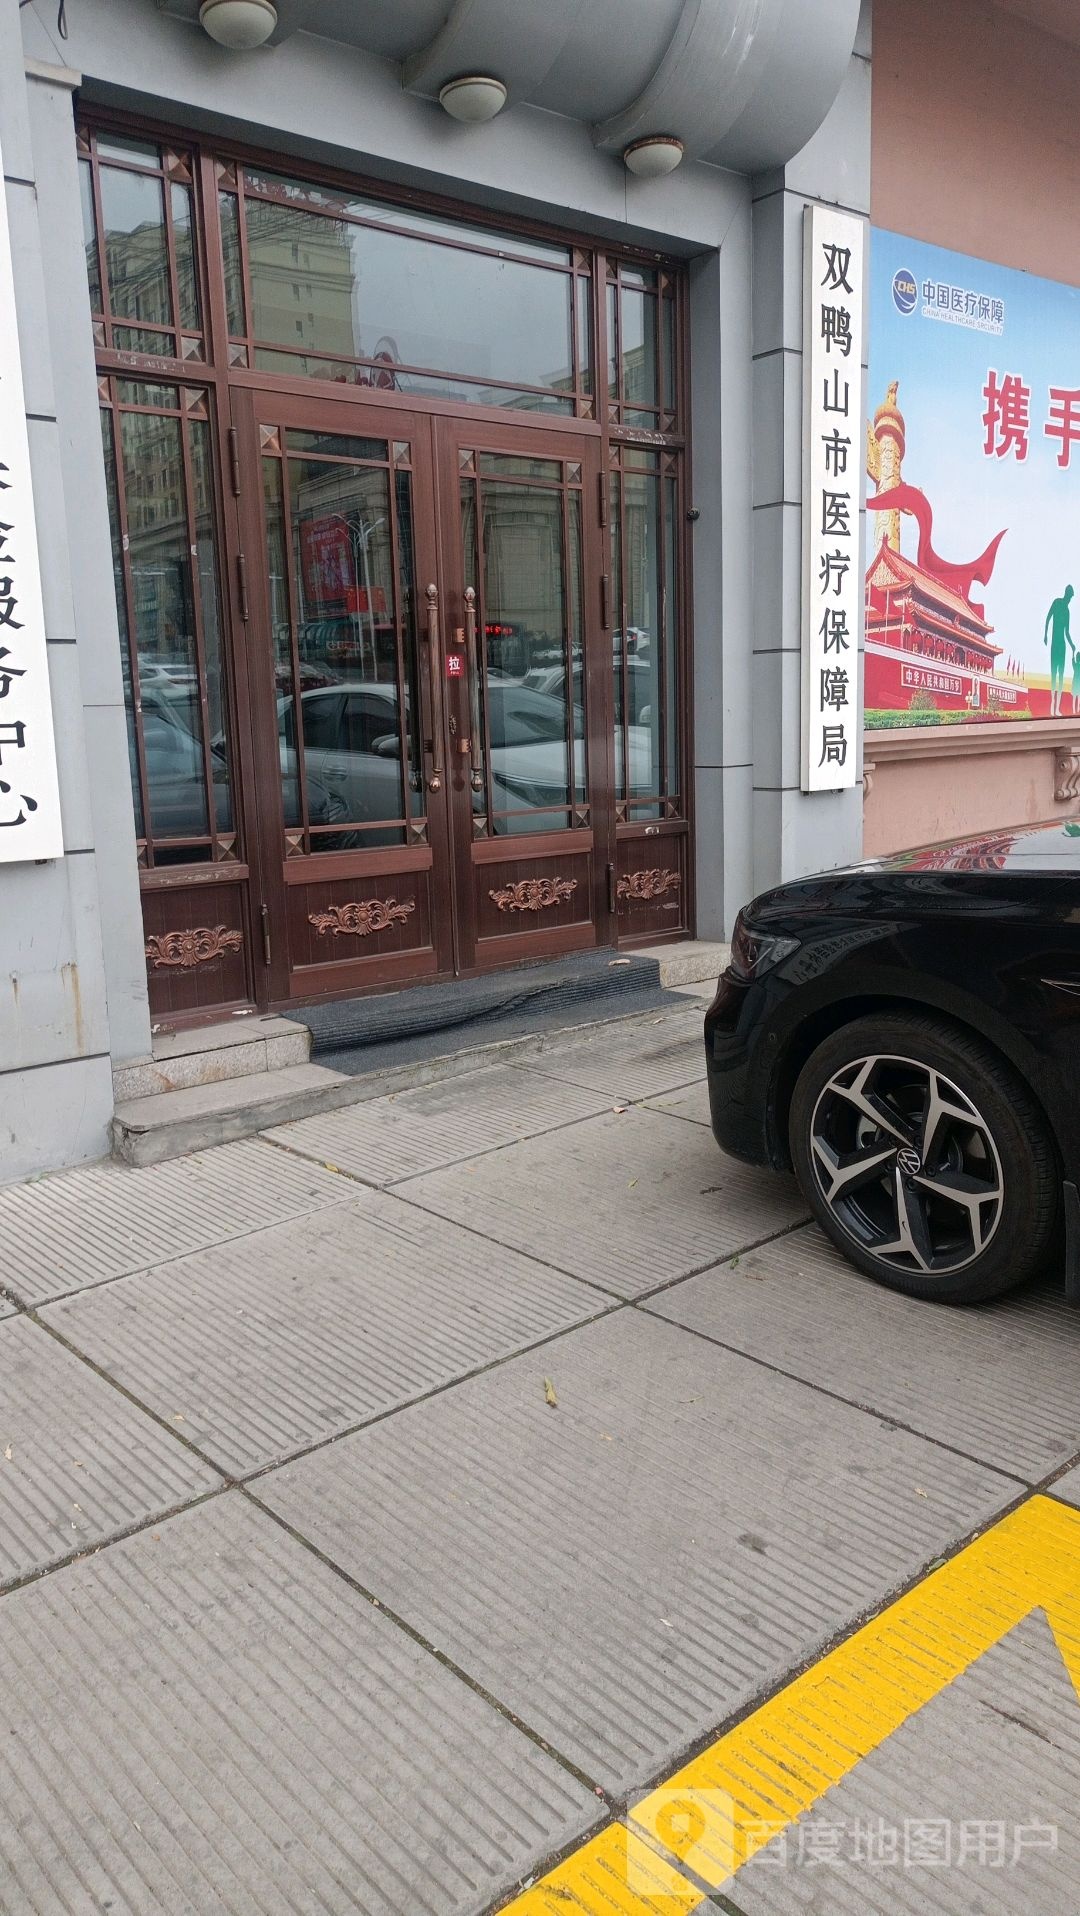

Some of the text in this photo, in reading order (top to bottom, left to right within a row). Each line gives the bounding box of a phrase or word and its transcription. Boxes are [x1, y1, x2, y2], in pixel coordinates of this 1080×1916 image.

[922, 281, 1003, 324] 中国医疗保障
[922, 308, 939, 317] CHINA
[818, 243, 853, 767] 双鸭山市医疗保障局
[449, 656, 460, 670] 拉
